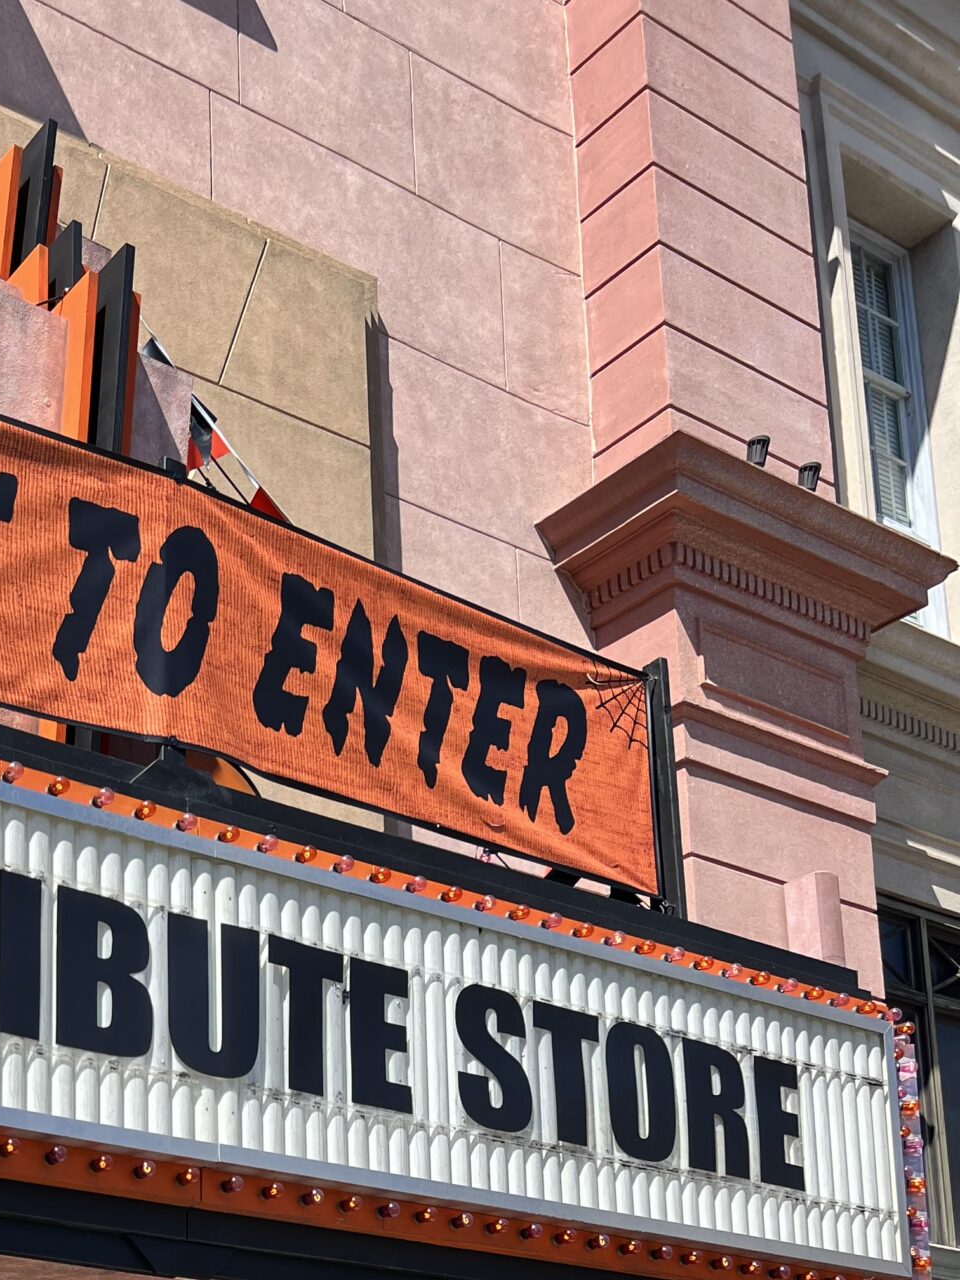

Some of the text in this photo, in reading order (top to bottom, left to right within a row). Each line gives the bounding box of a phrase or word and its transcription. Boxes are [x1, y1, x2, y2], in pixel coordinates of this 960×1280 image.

[52, 497, 219, 698] TO
[252, 572, 588, 835] ENTER
[455, 983, 806, 1192] STORE
